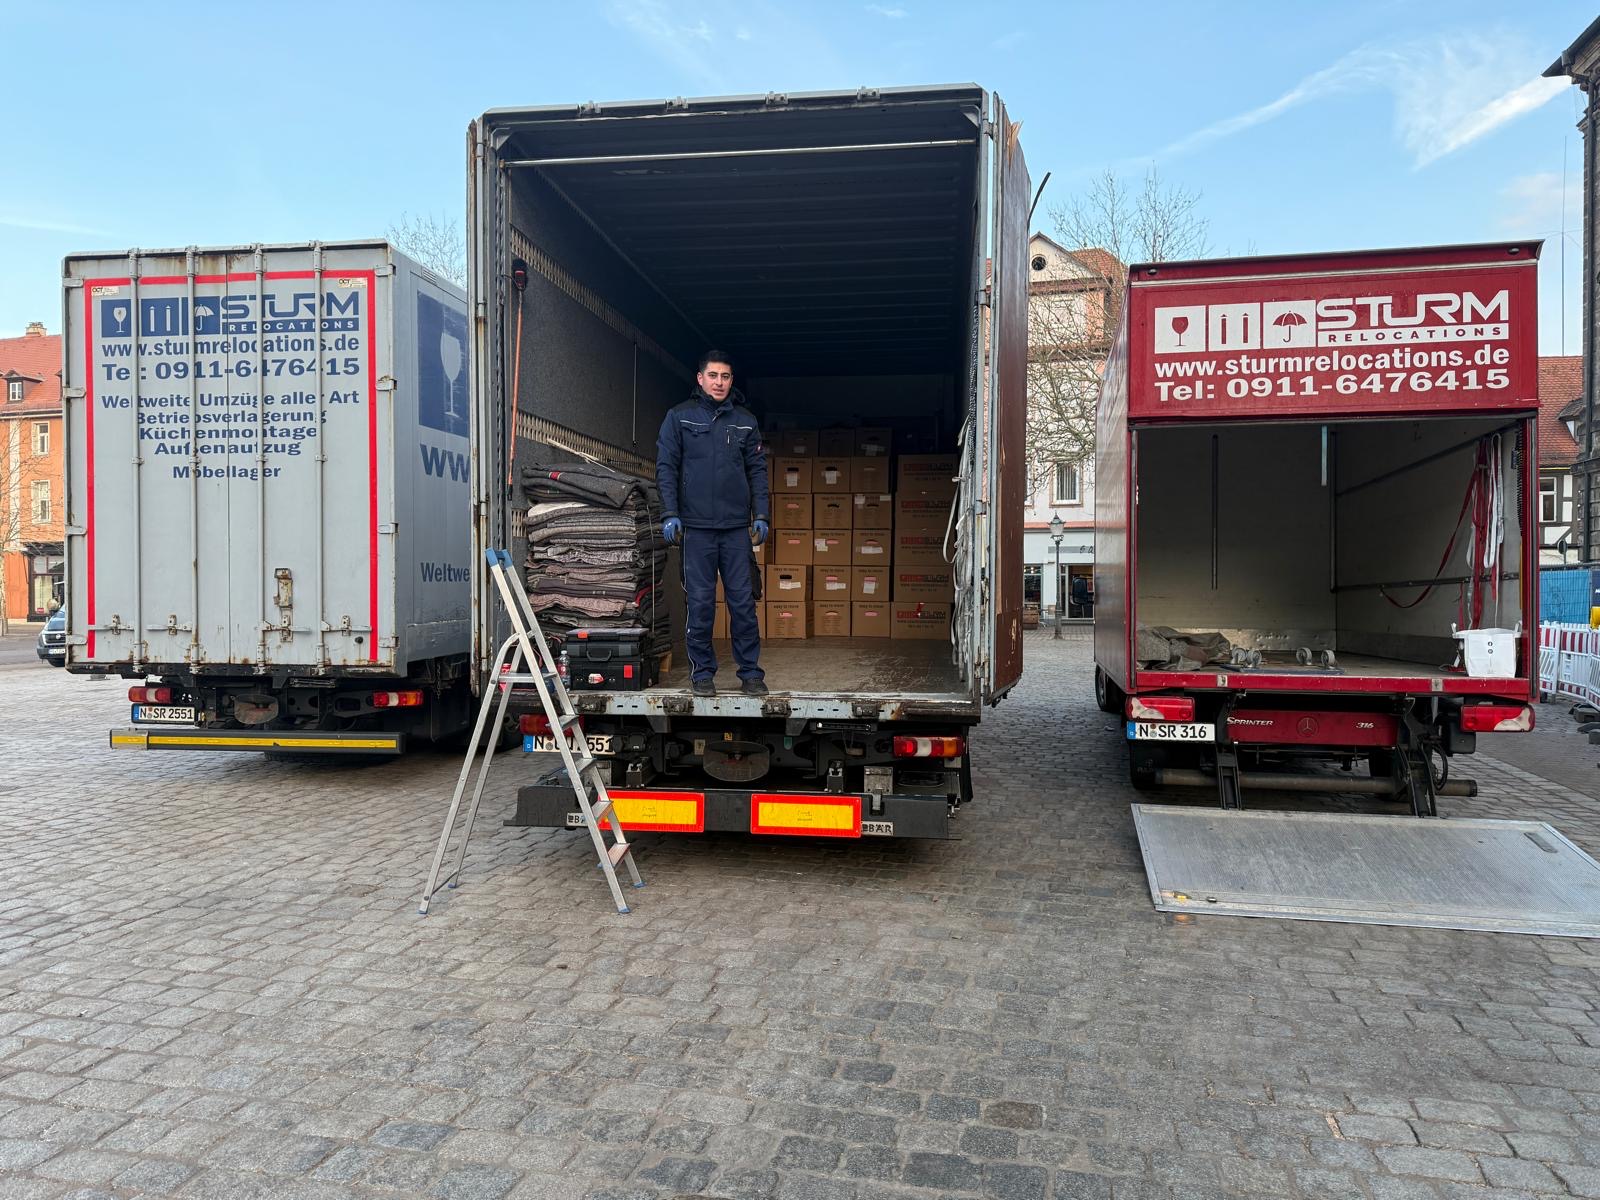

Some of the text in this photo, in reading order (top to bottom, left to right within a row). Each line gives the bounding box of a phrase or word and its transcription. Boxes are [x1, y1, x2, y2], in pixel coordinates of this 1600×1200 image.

[221, 291, 359, 319] STURM
[1317, 290, 1509, 329] STURM
[1328, 327, 1501, 343] RELOCATIONS
[1154, 344, 1510, 378] www.sturmrelocations.de
[102, 363, 147, 380] Te:
[1154, 369, 1510, 401] Tel: 0911-6476415
[281, 391, 325, 405] alle
[329, 390, 360, 404] Art
[140, 707, 193, 719] N SR 2551
[1140, 724, 1149, 737] N
[1158, 725, 1177, 738] SR
[1180, 725, 1207, 739] 316
[534, 735, 545, 750] N
[577, 736, 614, 753] 551
